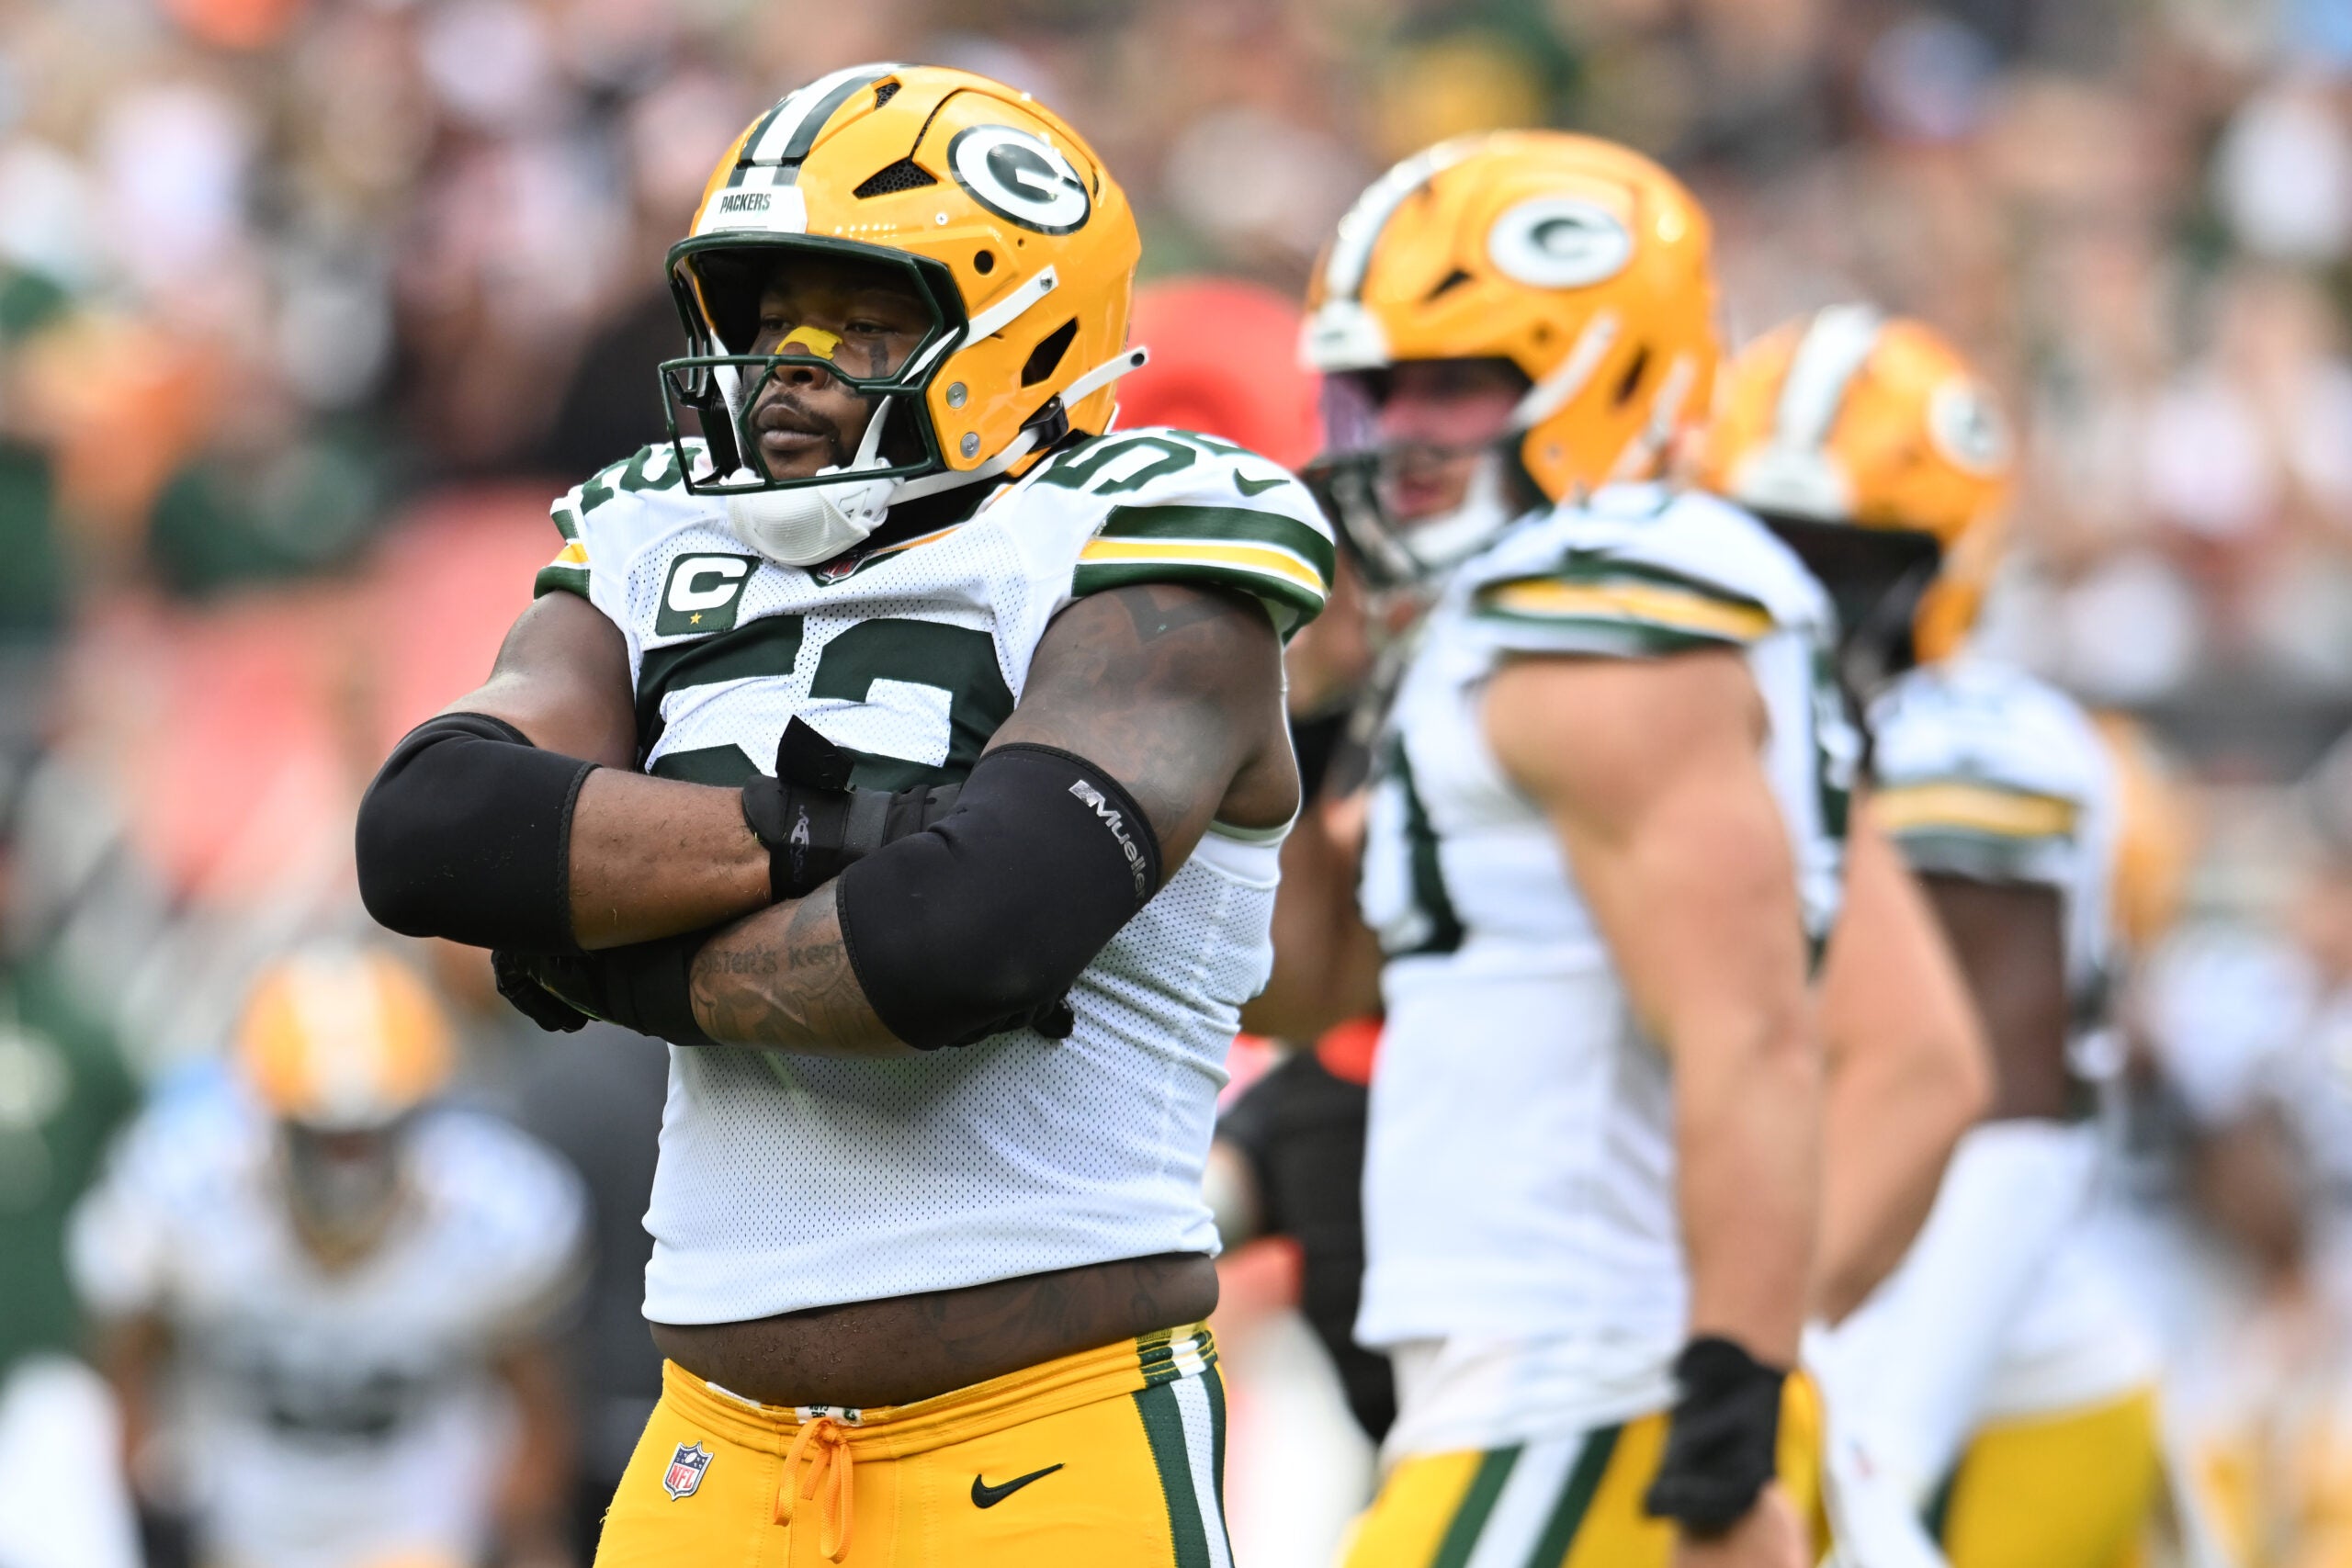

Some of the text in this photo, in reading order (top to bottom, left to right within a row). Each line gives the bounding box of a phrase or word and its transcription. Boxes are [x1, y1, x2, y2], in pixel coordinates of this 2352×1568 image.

[718, 193, 772, 215] PACKERS
[667, 556, 748, 613] C
[1084, 790, 1147, 900] Mueller
[667, 1463, 695, 1490] NFL
